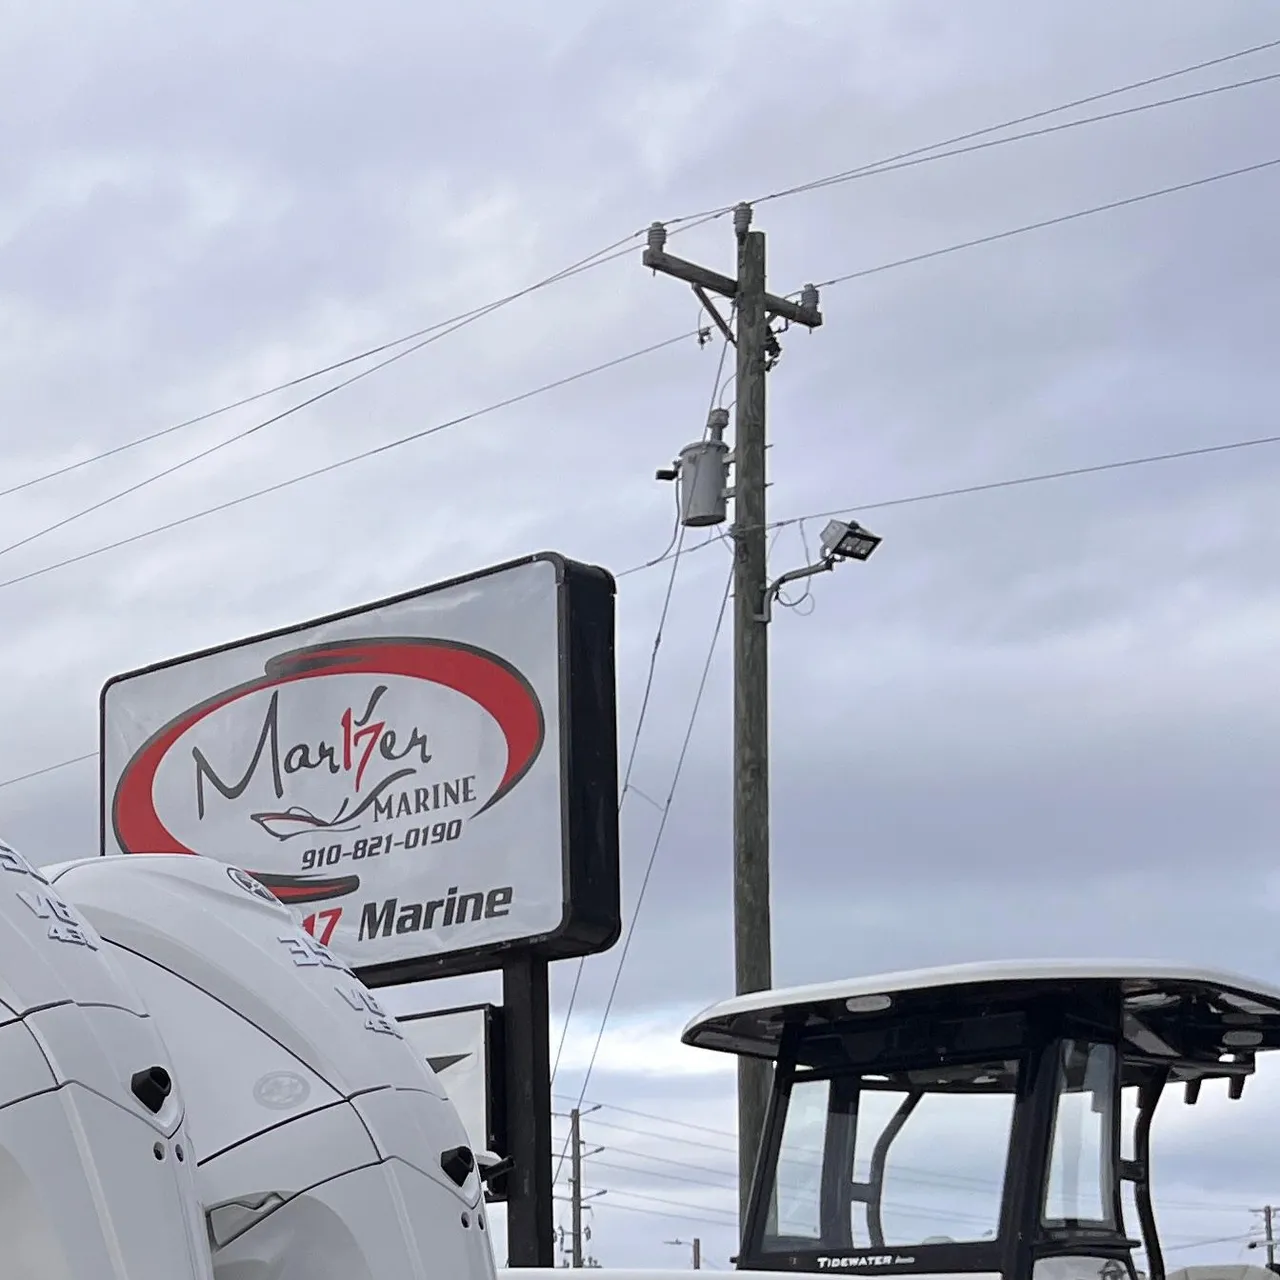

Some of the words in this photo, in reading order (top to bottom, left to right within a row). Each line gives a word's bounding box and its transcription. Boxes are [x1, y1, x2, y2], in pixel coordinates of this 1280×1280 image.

[372, 775, 478, 823] MARINE
[301, 818, 463, 871] 910-821-0190
[357, 886, 513, 942] Marine
[817, 1255, 893, 1269] TIDEWATER
